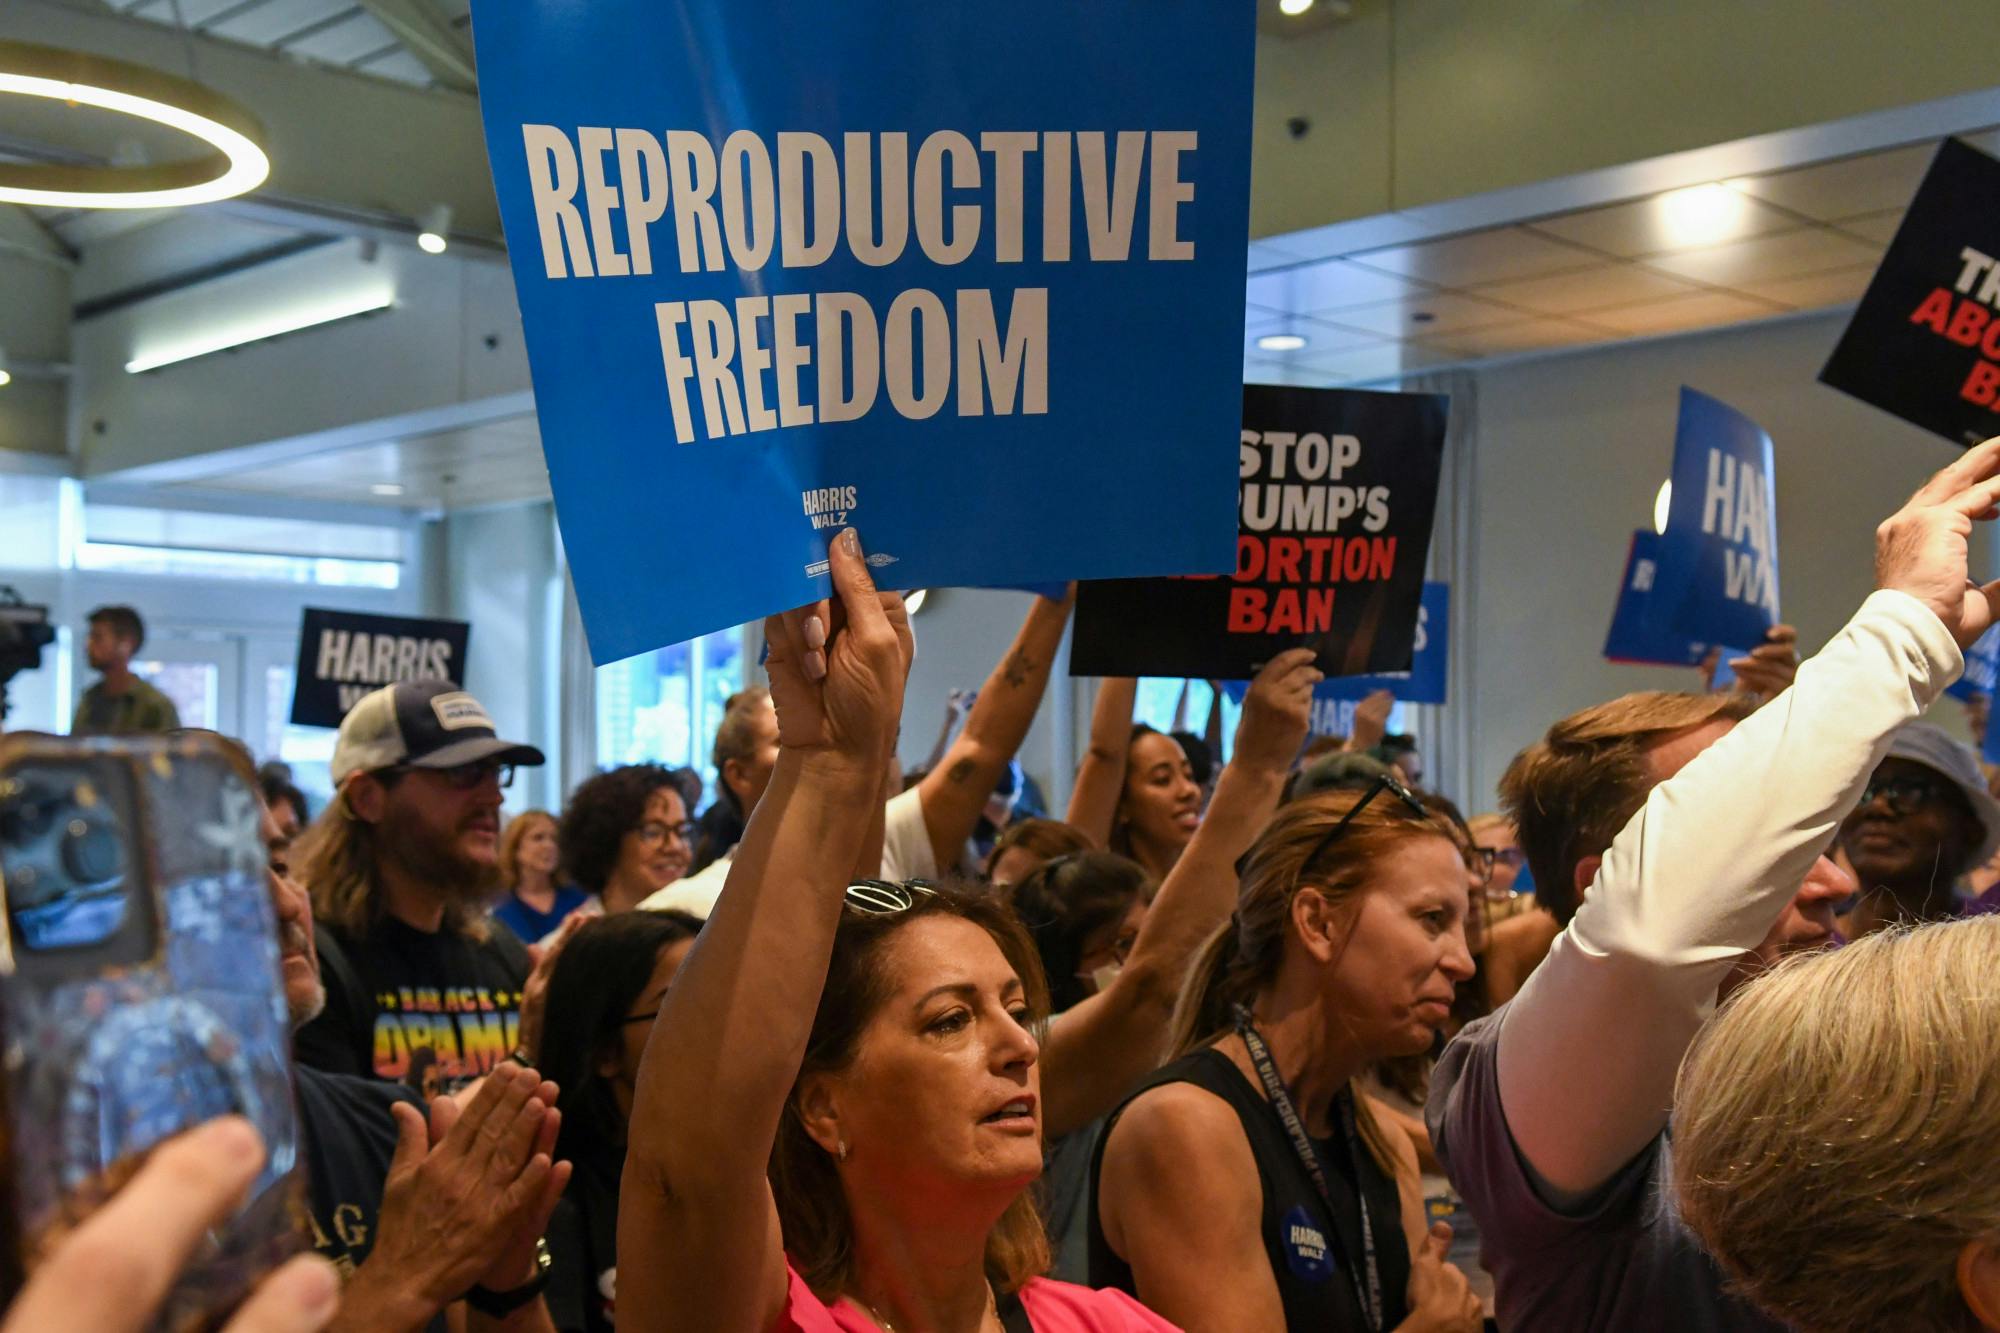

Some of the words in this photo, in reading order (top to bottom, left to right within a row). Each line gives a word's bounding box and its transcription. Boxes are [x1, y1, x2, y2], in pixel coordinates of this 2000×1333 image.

[522, 123, 1198, 279] REPRODUCTIVE
[655, 287, 1048, 444] FREEDOM
[1960, 359, 2000, 413] B
[1239, 429, 1361, 481] STOP
[802, 485, 857, 516] HARRIS
[811, 511, 848, 529] WALZ
[1238, 483, 1391, 532] UMP'S
[1227, 587, 1336, 634] BAN
[315, 629, 453, 682] HARRIS
